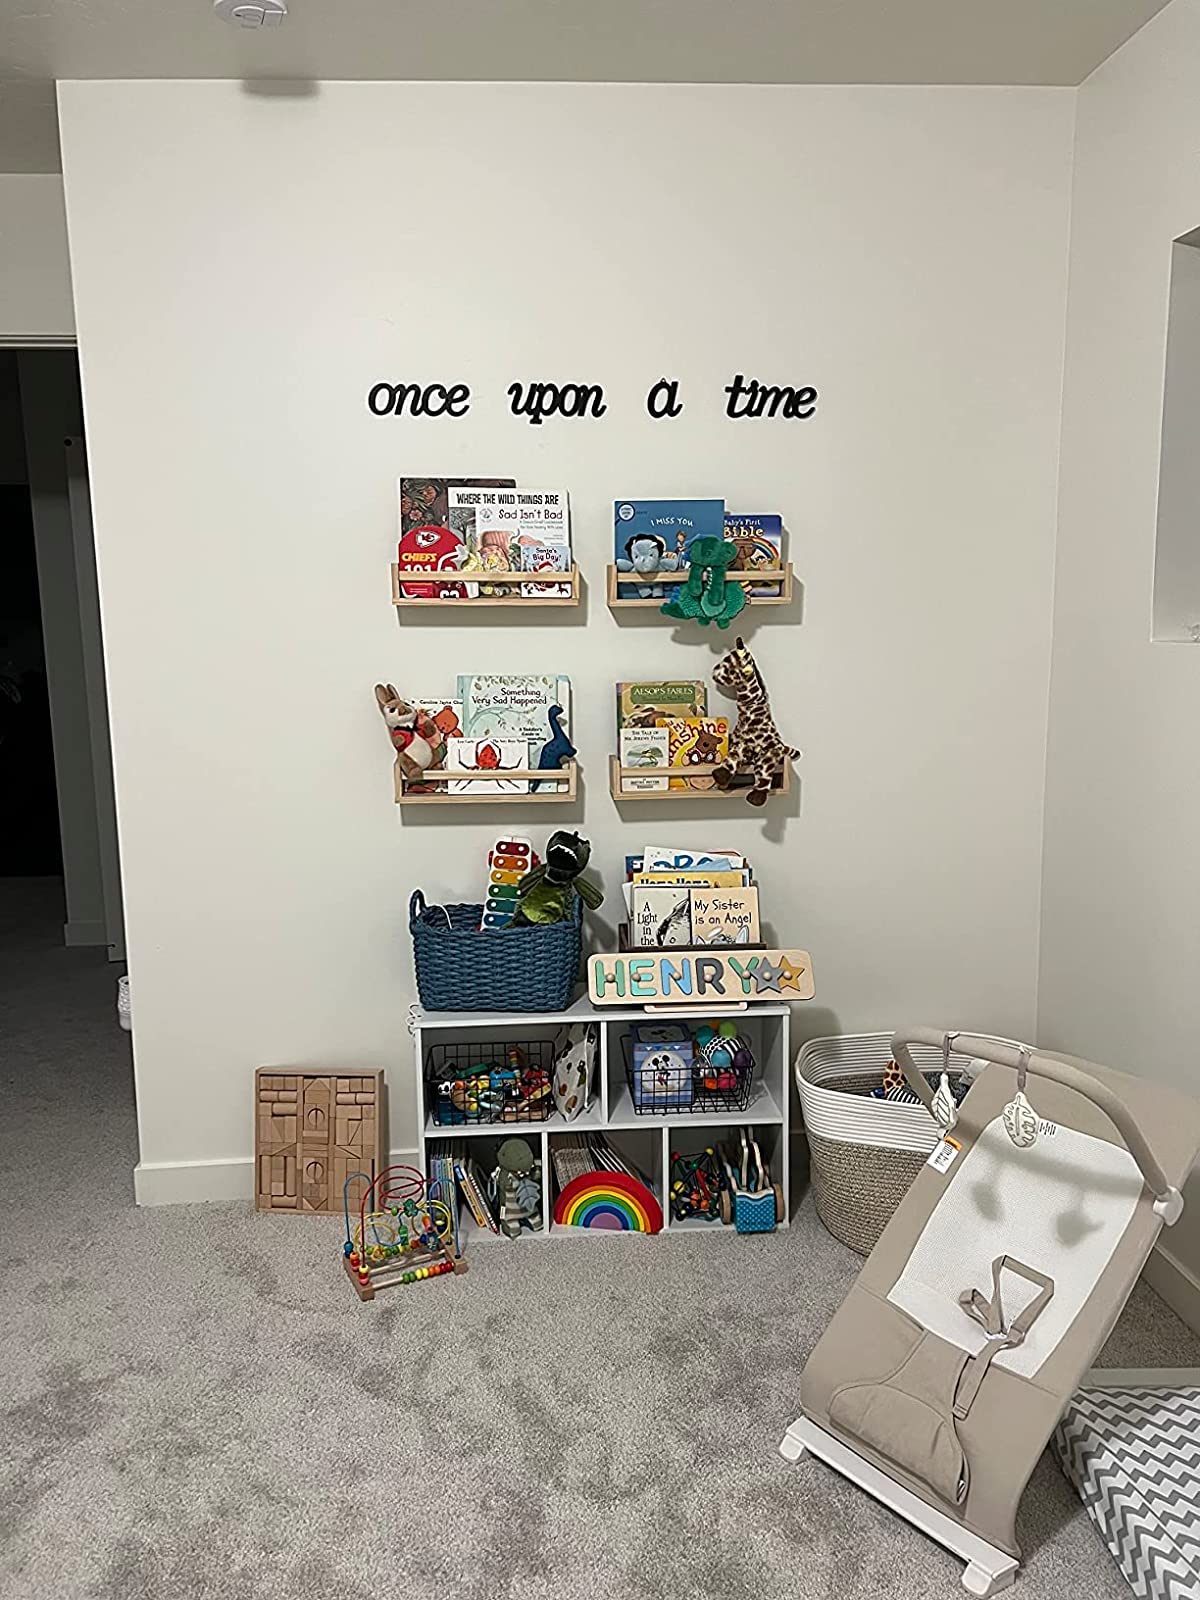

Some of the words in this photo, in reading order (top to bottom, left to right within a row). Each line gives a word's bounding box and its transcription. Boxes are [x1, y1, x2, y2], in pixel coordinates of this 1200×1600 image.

[368, 381, 470, 418] once
[508, 380, 607, 424] upon
[647, 377, 683, 419] a
[725, 375, 818, 420] time
[456, 493, 481, 505] WHERE
[483, 493, 496, 505] THE
[498, 493, 515, 505] WILD
[517, 494, 543, 505] THINGS
[544, 494, 559, 506] ARE
[498, 508, 518, 520] Sad
[519, 509, 542, 520] Isn't
[544, 509, 563, 520] Bad
[651, 519, 655, 527] I
[656, 517, 675, 526] MISS
[677, 517, 694, 528] YOU
[723, 526, 764, 538] Bible
[401, 552, 438, 563] CHIEFS
[532, 553, 545, 561] Big
[500, 687, 542, 697] Something
[633, 687, 666, 695] AESOP'S
[667, 687, 693, 695] FABLES
[471, 696, 491, 706] Very
[493, 696, 508, 705] Sad
[510, 696, 547, 706] Happened
[643, 901, 651, 912] A
[694, 900, 709, 913] My
[712, 899, 745, 911] Sister
[637, 912, 658, 926] Light
[695, 915, 705, 925] is
[709, 915, 721, 925] an
[724, 912, 752, 928] Angel
[642, 926, 652, 935] in
[640, 935, 655, 946] the
[594, 956, 760, 998] HENRY
